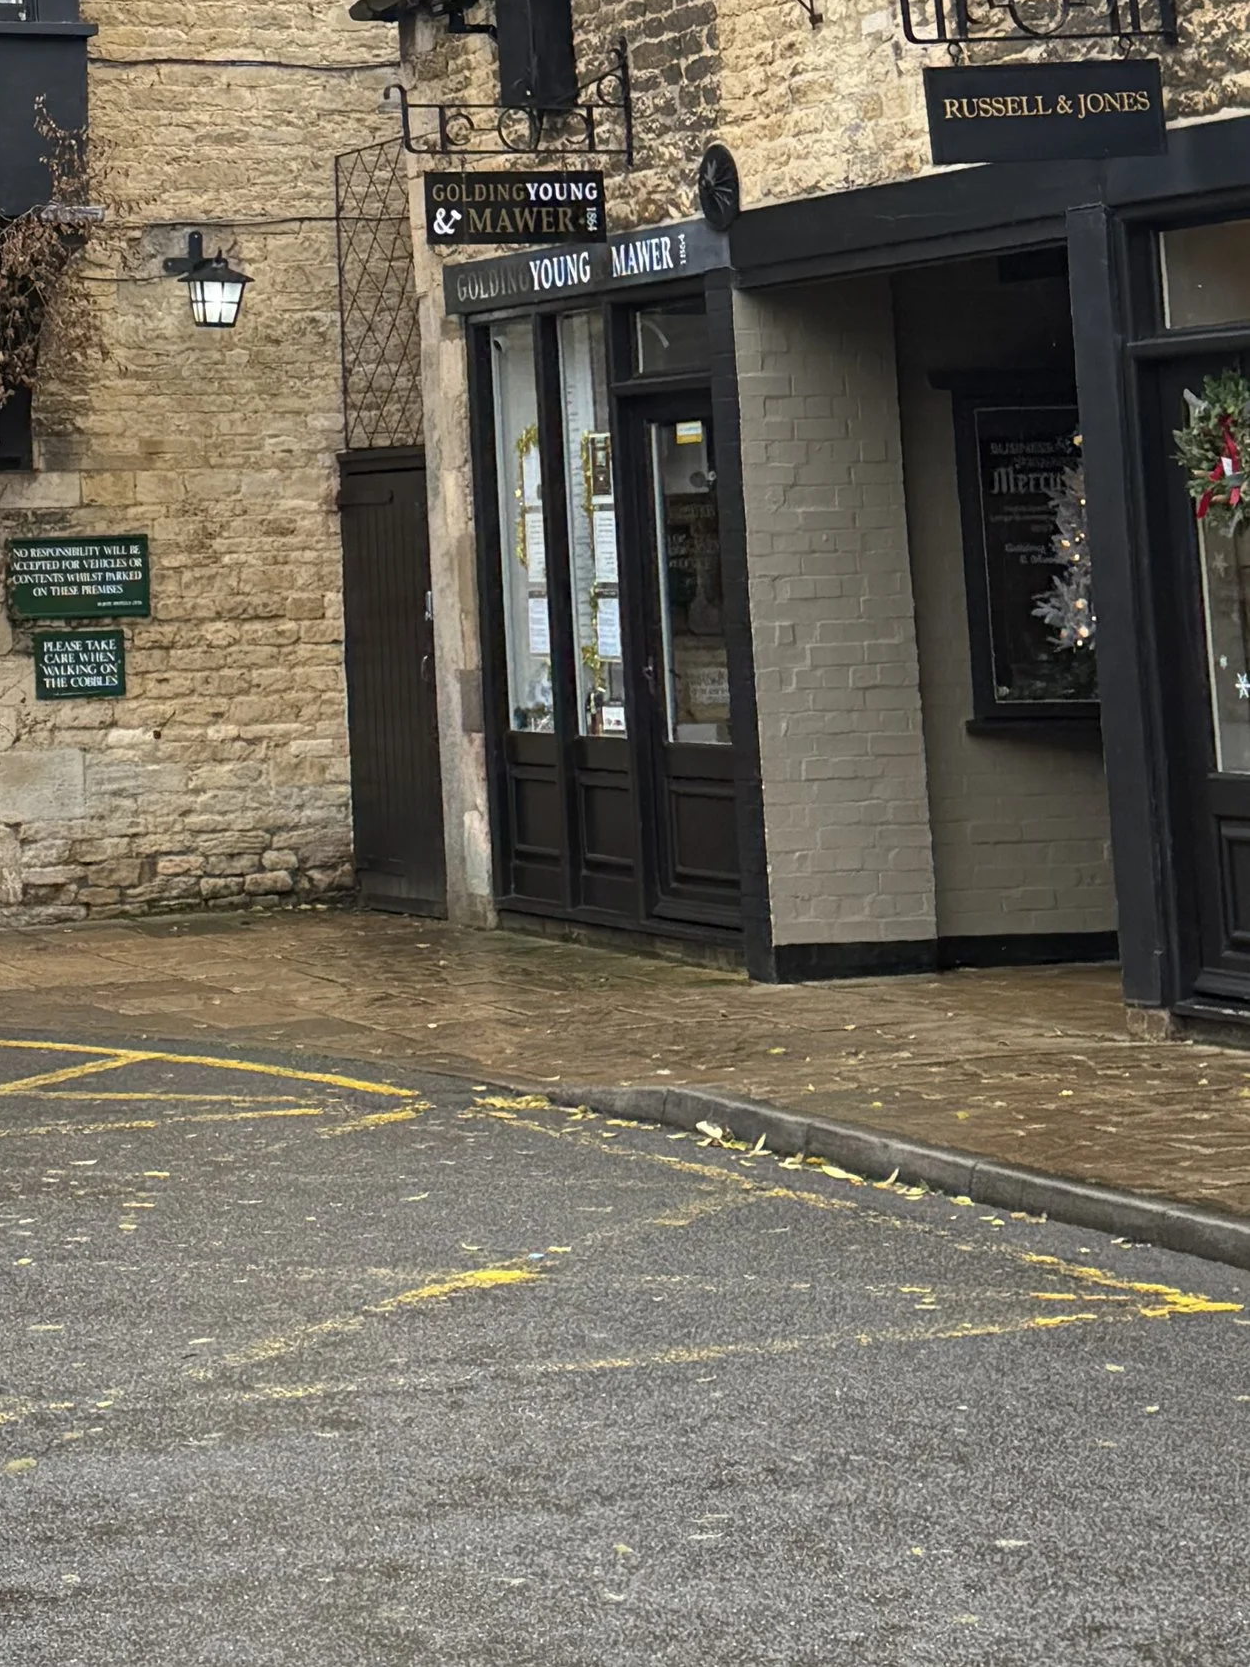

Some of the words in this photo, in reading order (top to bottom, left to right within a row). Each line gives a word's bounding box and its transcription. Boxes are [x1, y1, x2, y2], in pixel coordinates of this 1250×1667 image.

[943, 94, 1053, 121] RUSSELL
[1056, 94, 1074, 115] &
[1077, 91, 1152, 120] JONES
[433, 207, 463, 235] &
[468, 207, 576, 234] MAWER
[611, 235, 674, 278] MAWER
[990, 466, 1064, 495] Mercu
[13, 548, 29, 558] NO
[30, 545, 101, 558] RESPONSIBILITY
[103, 545, 127, 555] WILL
[130, 544, 141, 555] BE
[12, 560, 60, 571] ACCEPTED
[62, 559, 80, 570] FOR
[83, 558, 128, 569] VEHICLES
[129, 557, 142, 568] OR
[12, 573, 64, 585] CONTENTS
[67, 572, 104, 583] WHILST
[106, 570, 143, 581] PARKED
[33, 586, 48, 597] ON
[51, 585, 79, 596] THESE
[82, 584, 124, 595] PREMISES
[44, 640, 83, 653] PLEASE
[86, 639, 117, 651] TAKE
[44, 653, 76, 664] CARE
[80, 652, 116, 663] WHEN
[42, 664, 97, 676] WALKING
[100, 663, 118, 674] ON
[44, 677, 68, 689] THE
[71, 676, 119, 687] COBBLES
